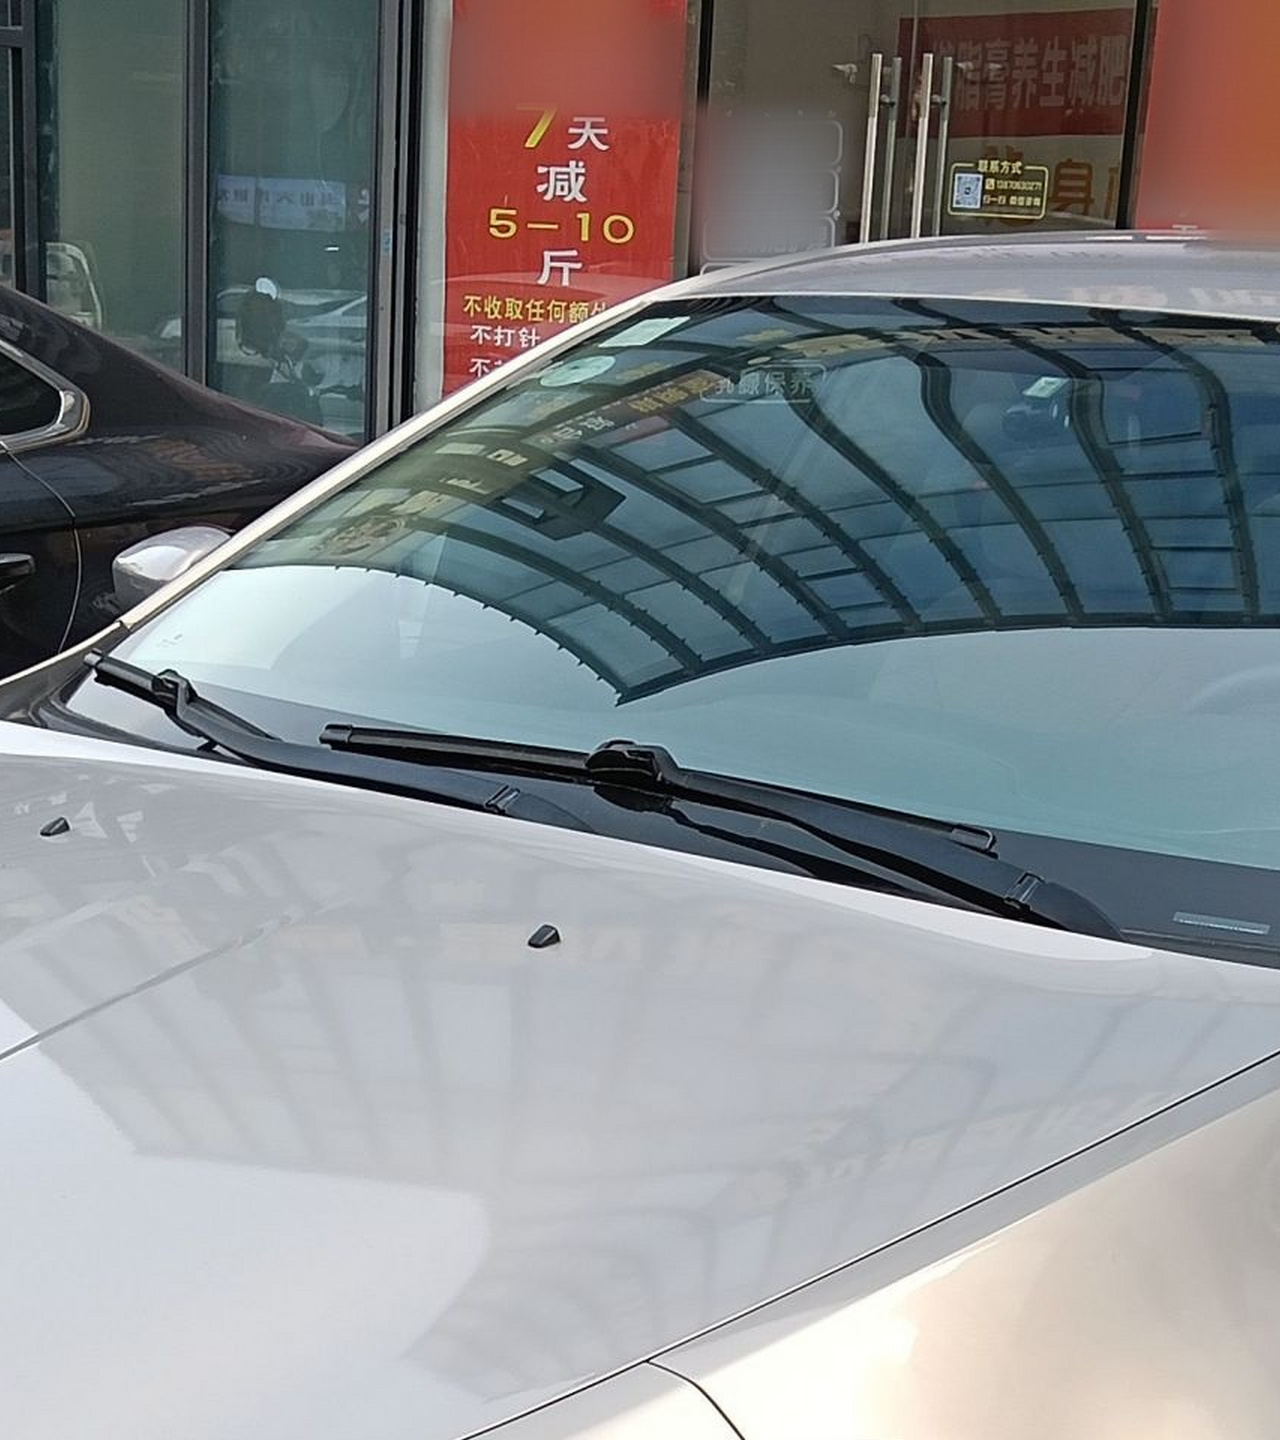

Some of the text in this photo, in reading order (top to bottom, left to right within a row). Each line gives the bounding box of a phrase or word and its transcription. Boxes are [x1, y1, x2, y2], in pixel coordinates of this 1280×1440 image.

[934, 35, 1127, 110] 脂膏养生减肥
[536, 160, 588, 203] 减
[537, 249, 583, 287] 斤
[470, 325, 541, 347] 不打针
[469, 358, 503, 377] 不
